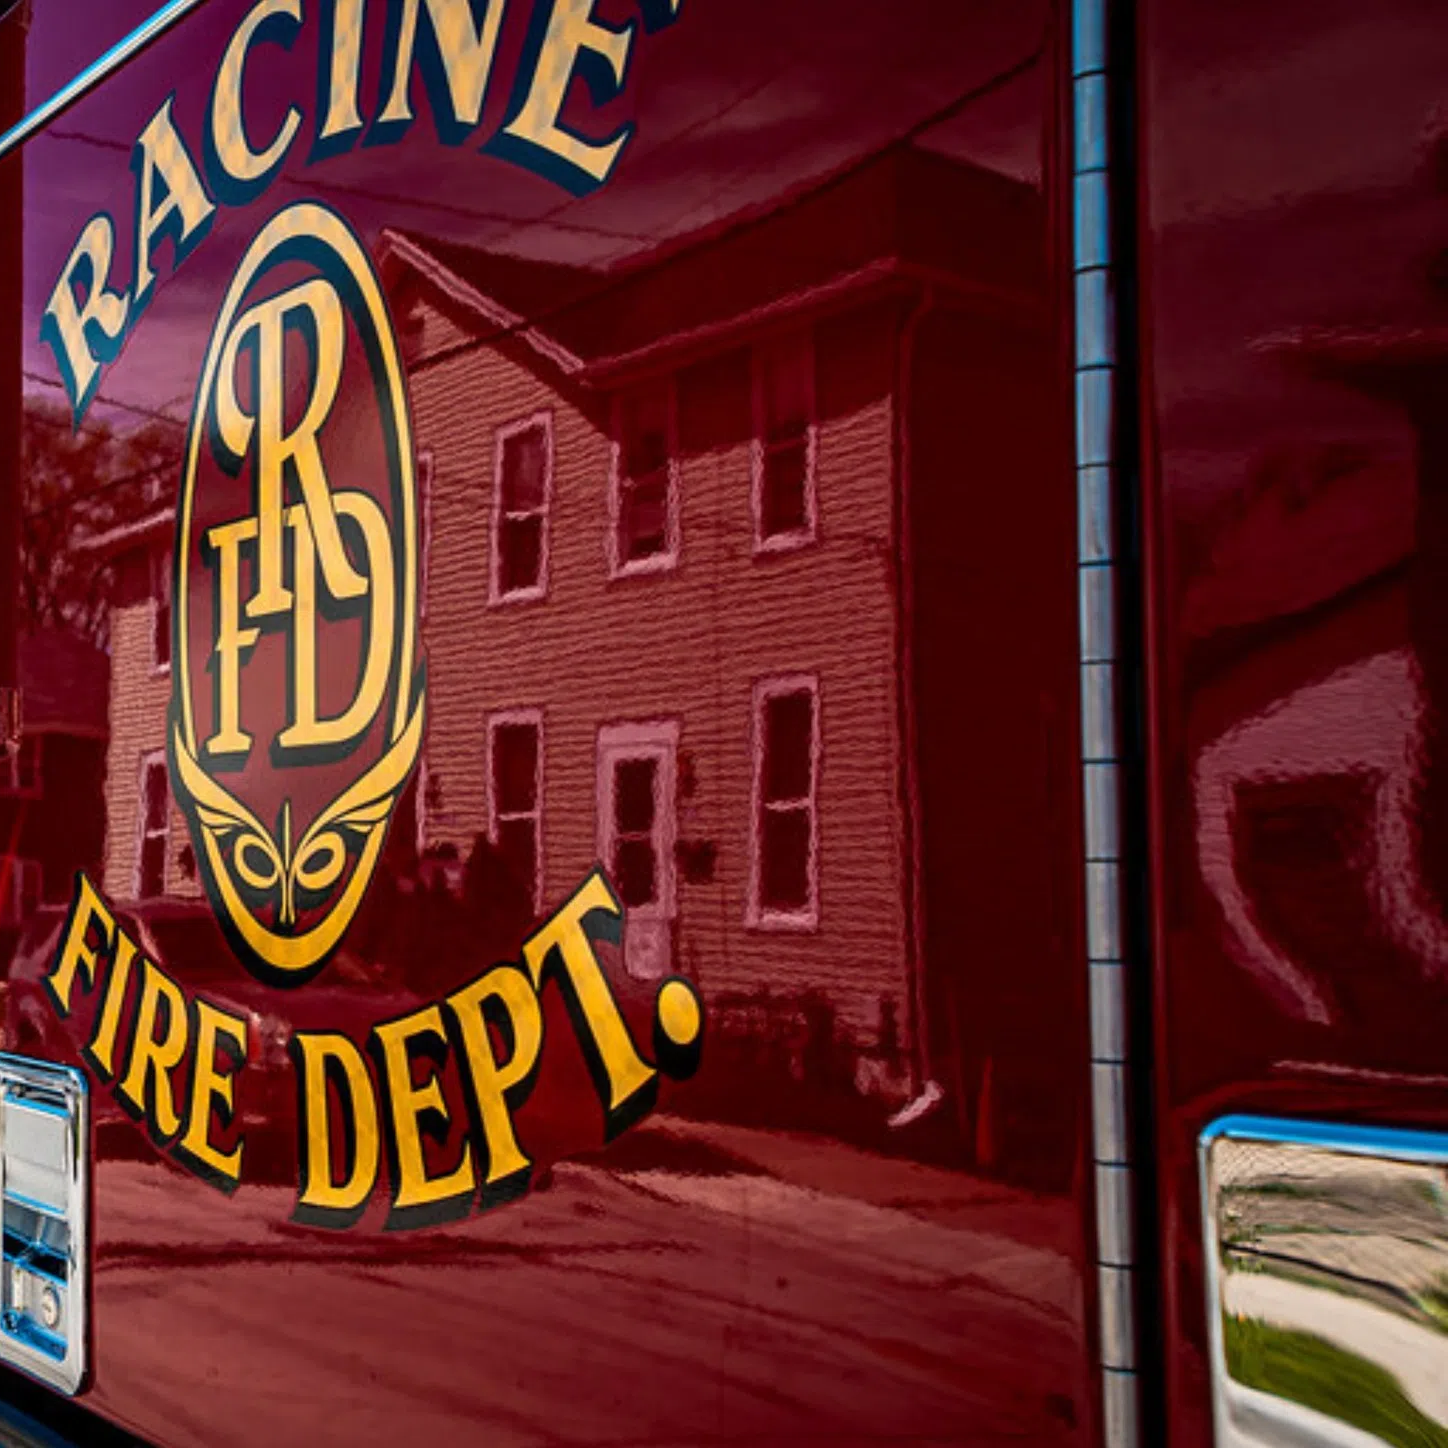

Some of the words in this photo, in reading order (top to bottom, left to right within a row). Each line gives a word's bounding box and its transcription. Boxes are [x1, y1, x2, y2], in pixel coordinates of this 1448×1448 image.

[43, 0, 681, 415] RACINE
[48, 870, 249, 1182] FIRE
[296, 870, 701, 1210] DEPT.
